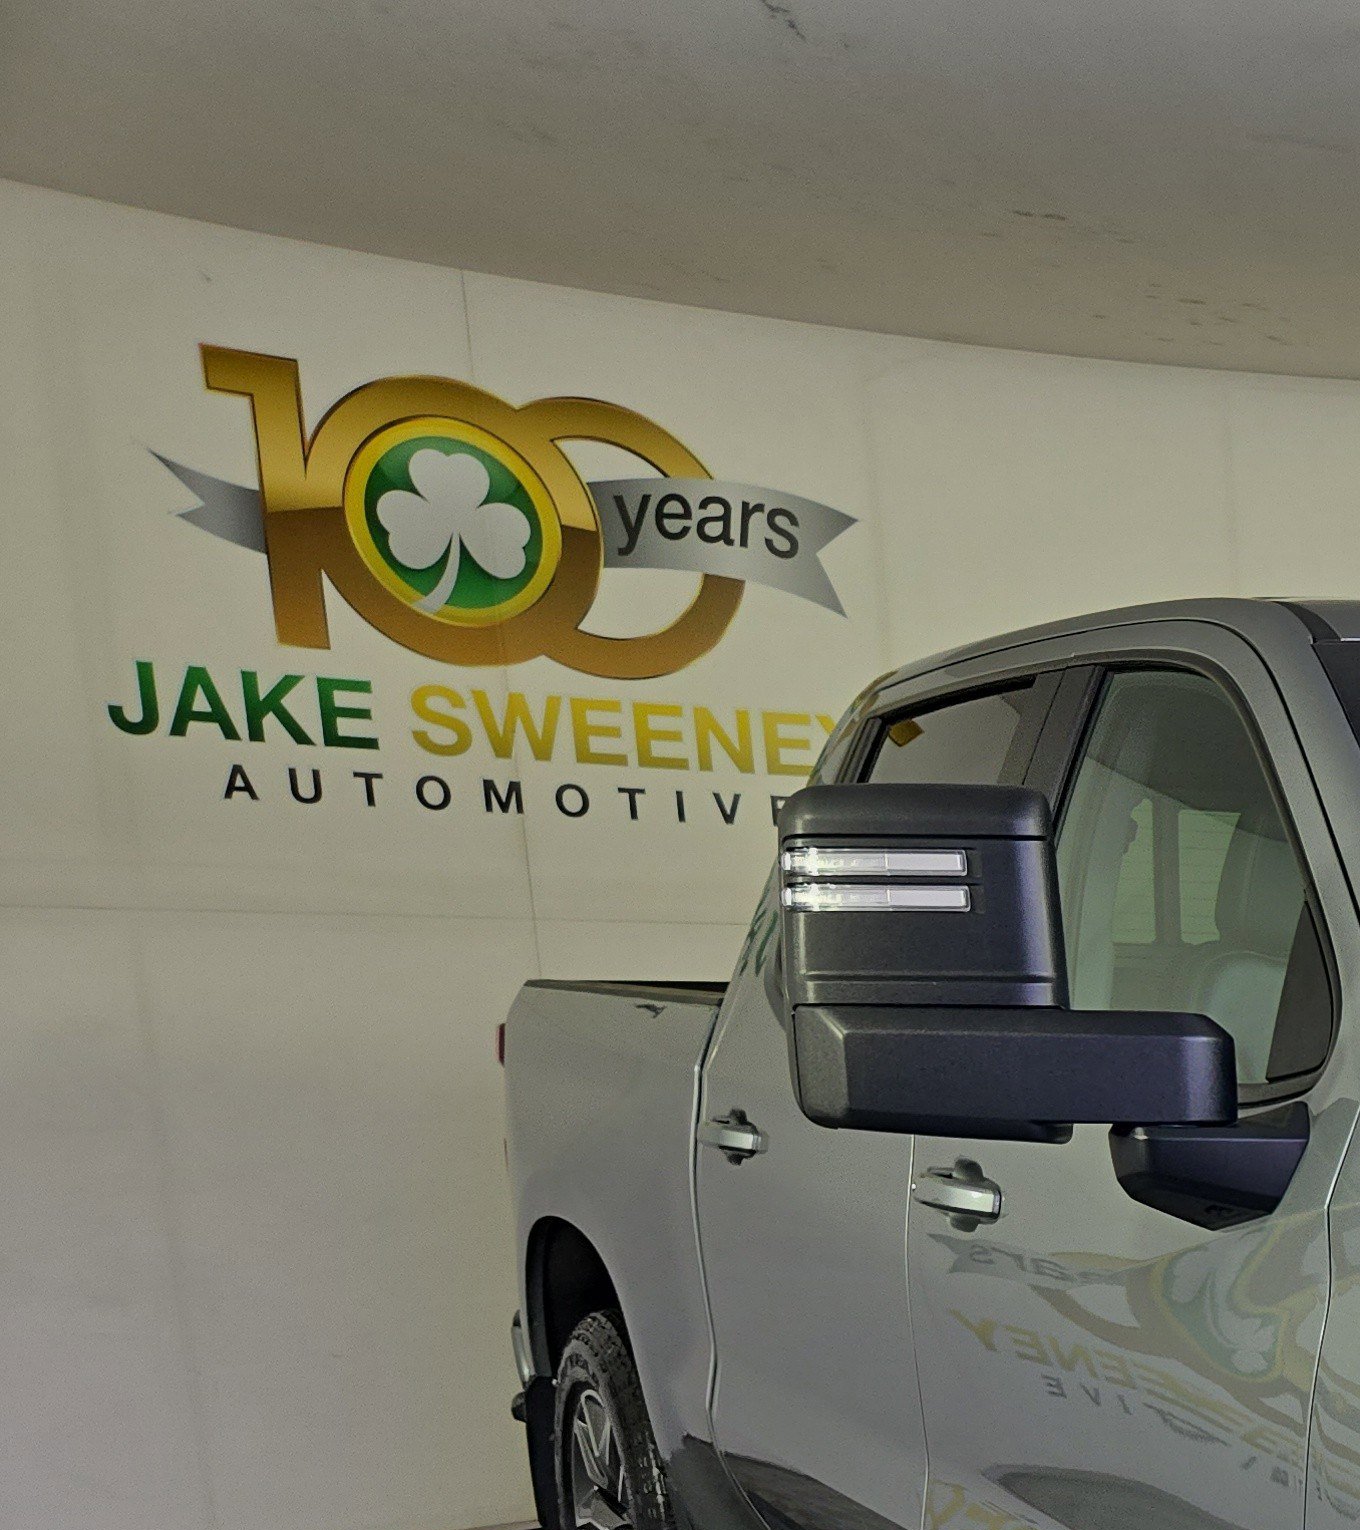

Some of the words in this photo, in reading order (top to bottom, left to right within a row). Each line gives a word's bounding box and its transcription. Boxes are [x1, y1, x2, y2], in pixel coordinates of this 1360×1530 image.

[200, 343, 746, 680] 100
[612, 492, 800, 559] years
[107, 661, 380, 751] JAKE
[410, 684, 837, 777] SWEENE
